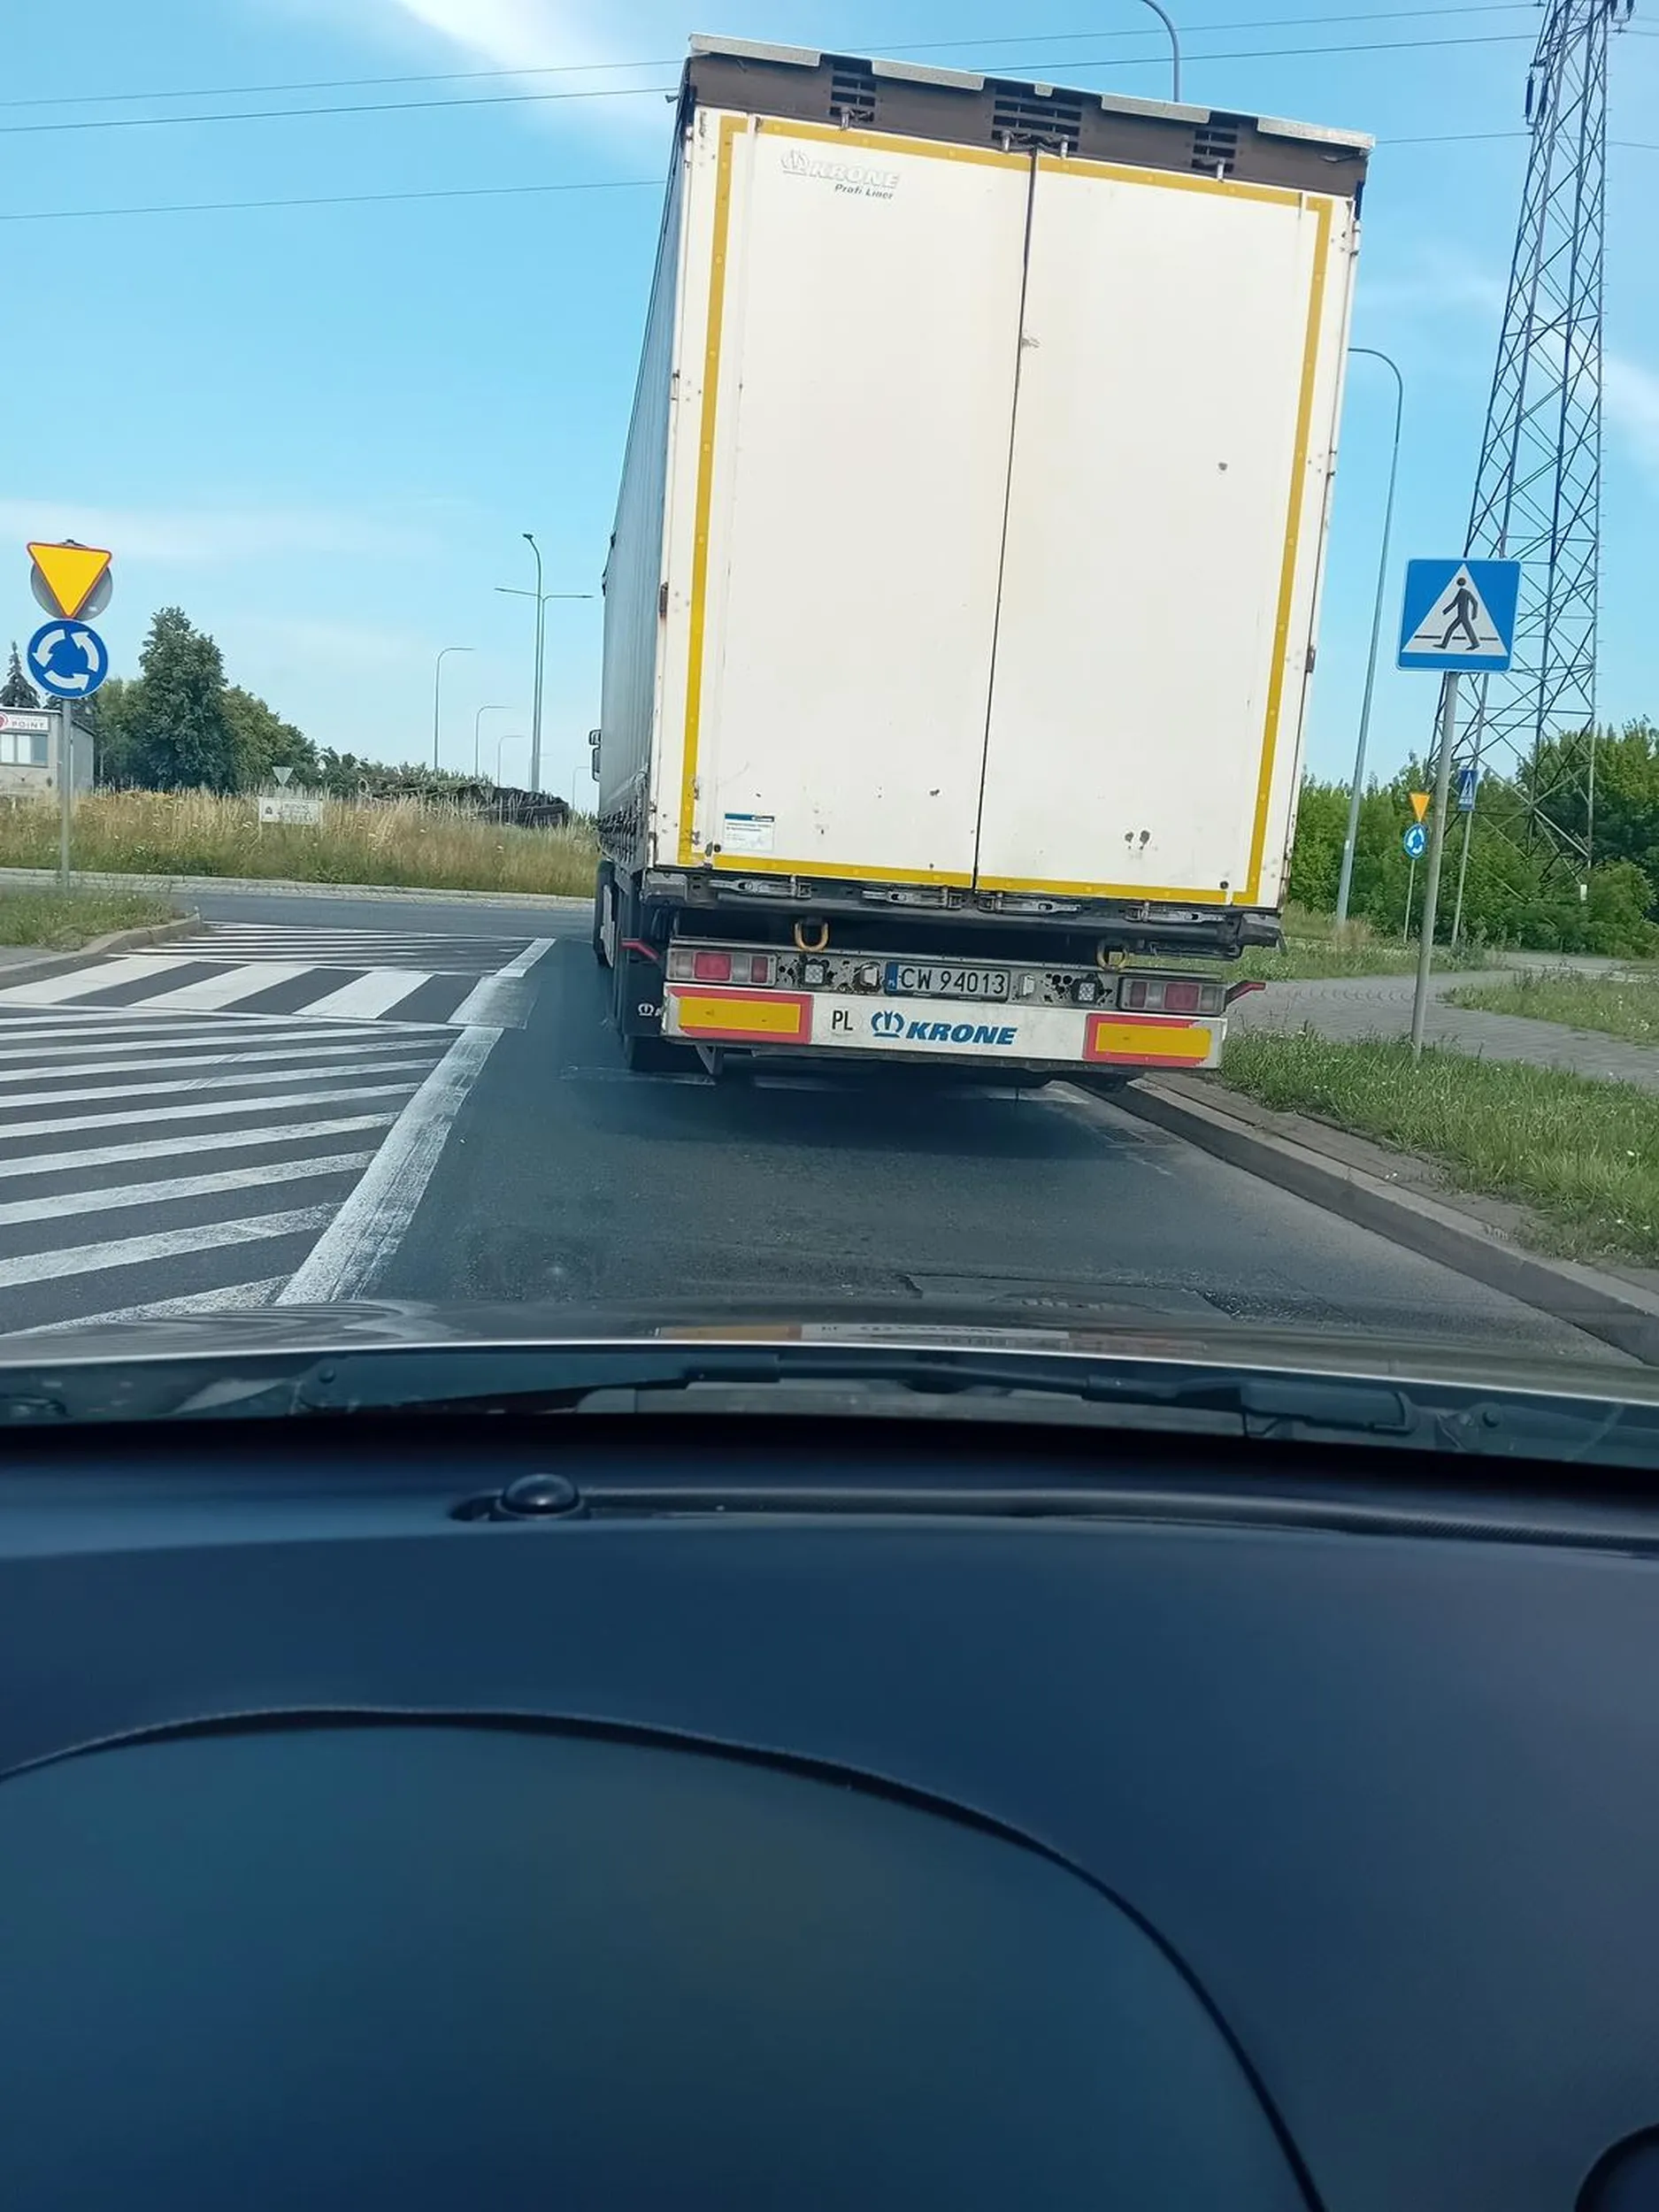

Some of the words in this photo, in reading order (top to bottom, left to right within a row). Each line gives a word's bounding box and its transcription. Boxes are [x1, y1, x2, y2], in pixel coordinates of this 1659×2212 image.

[810, 161, 899, 188] KRONE
[834, 182, 862, 196] Profi
[865, 188, 894, 200] Liner
[901, 968, 932, 990] CW
[940, 971, 1005, 995] 94013
[832, 1010, 854, 1031] PL
[906, 1021, 1018, 1045] KRONE
